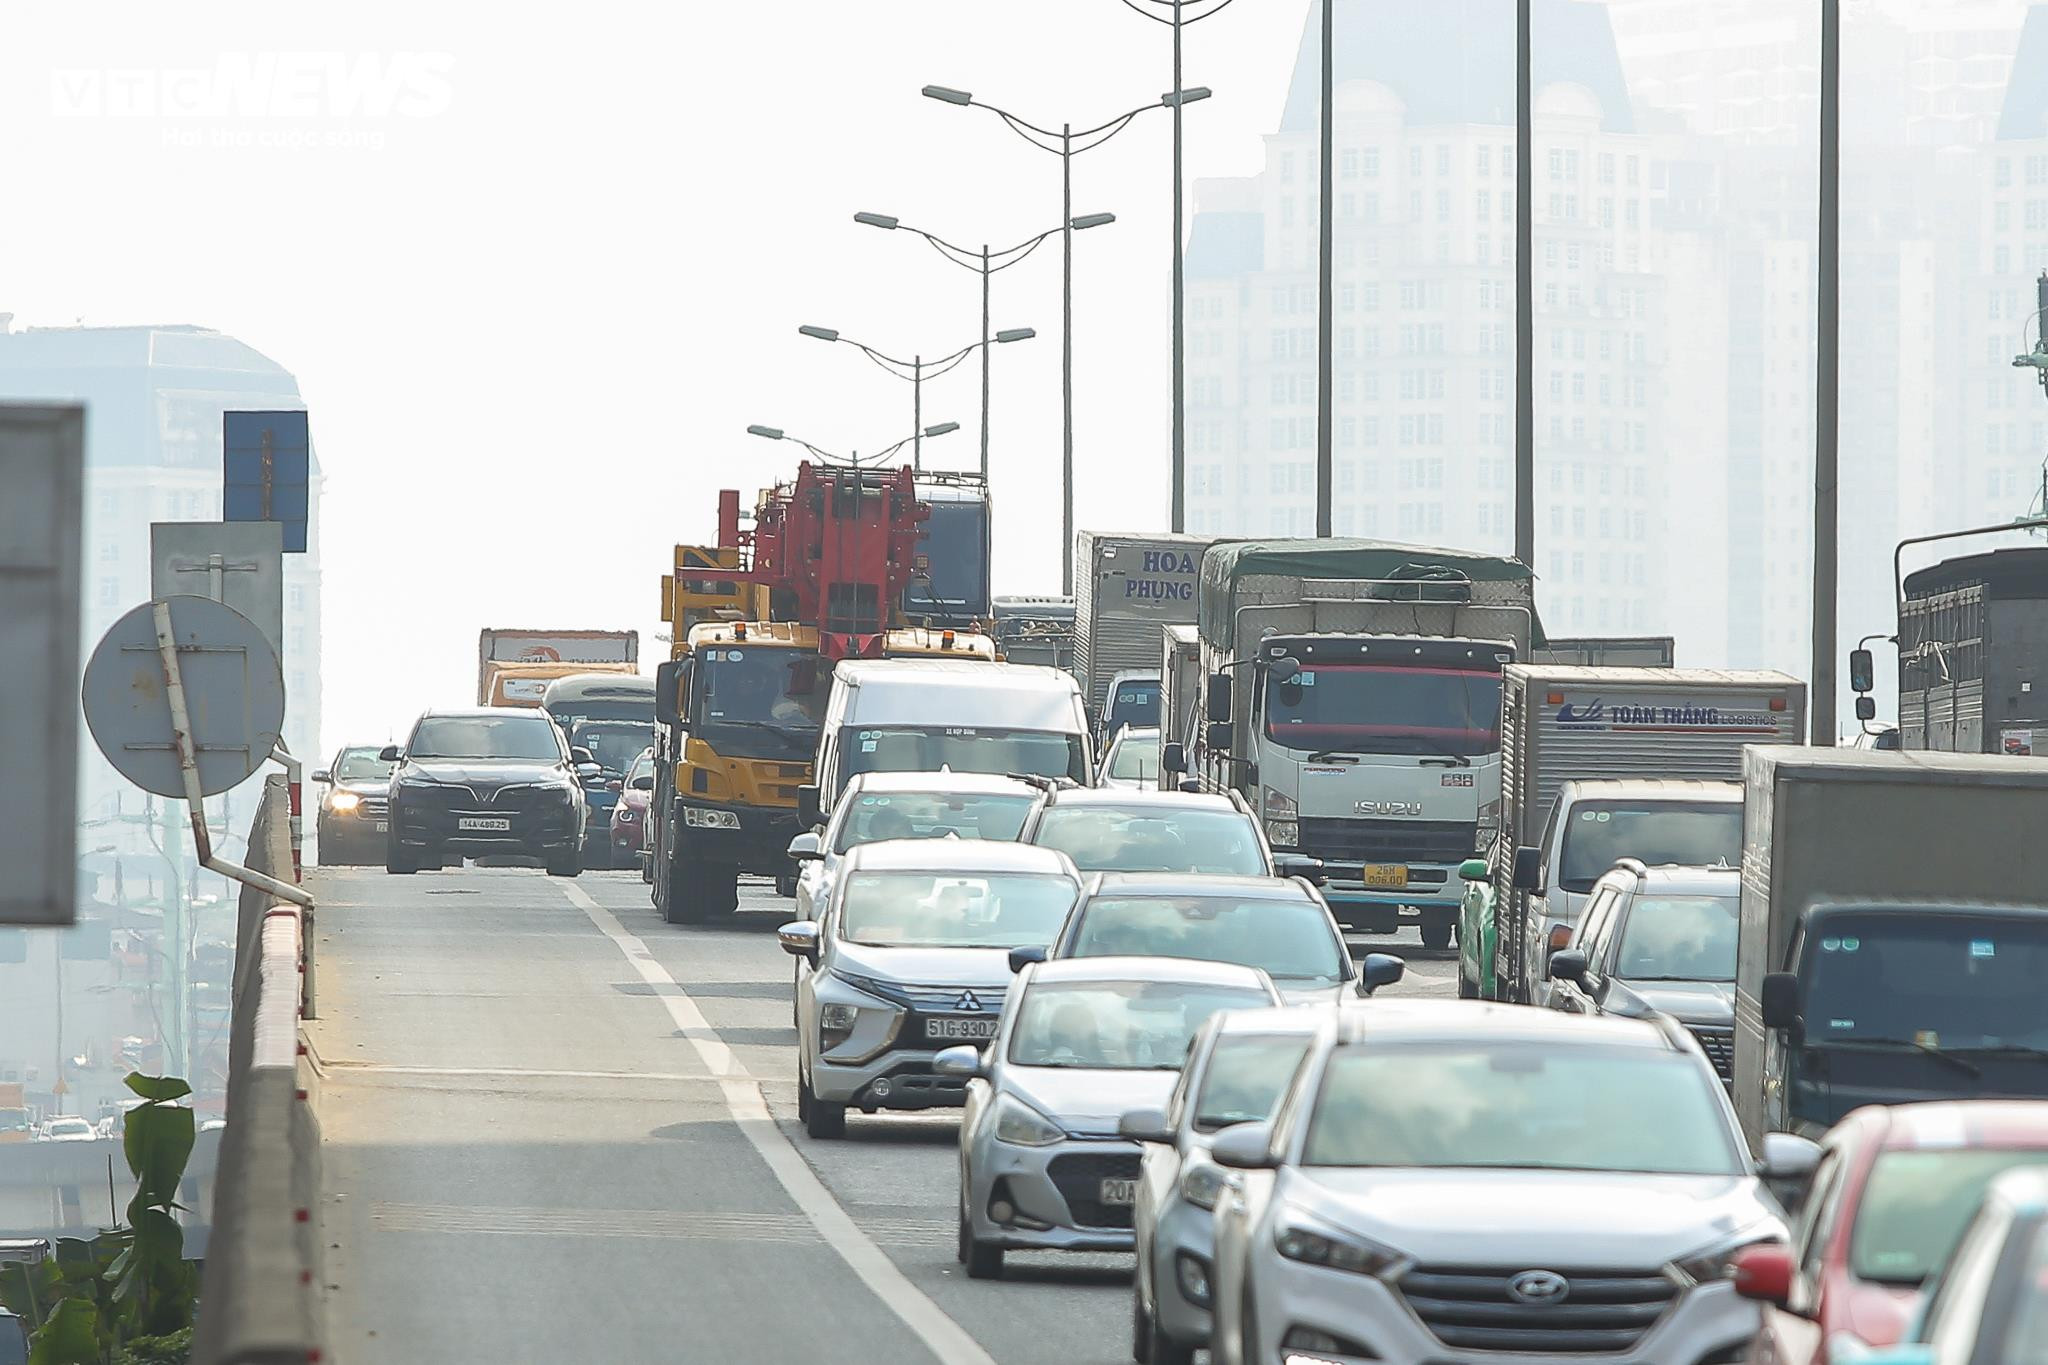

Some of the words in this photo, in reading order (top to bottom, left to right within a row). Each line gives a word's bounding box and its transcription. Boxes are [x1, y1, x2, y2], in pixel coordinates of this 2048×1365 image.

[1143, 552, 1196, 573] HOA
[1125, 579, 1193, 603] PHỤNG
[1611, 703, 1657, 724] TOÀN
[1661, 702, 1719, 725] THẮNG
[1720, 714, 1778, 726] LOGISTICS
[1354, 801, 1422, 815] ISUZU
